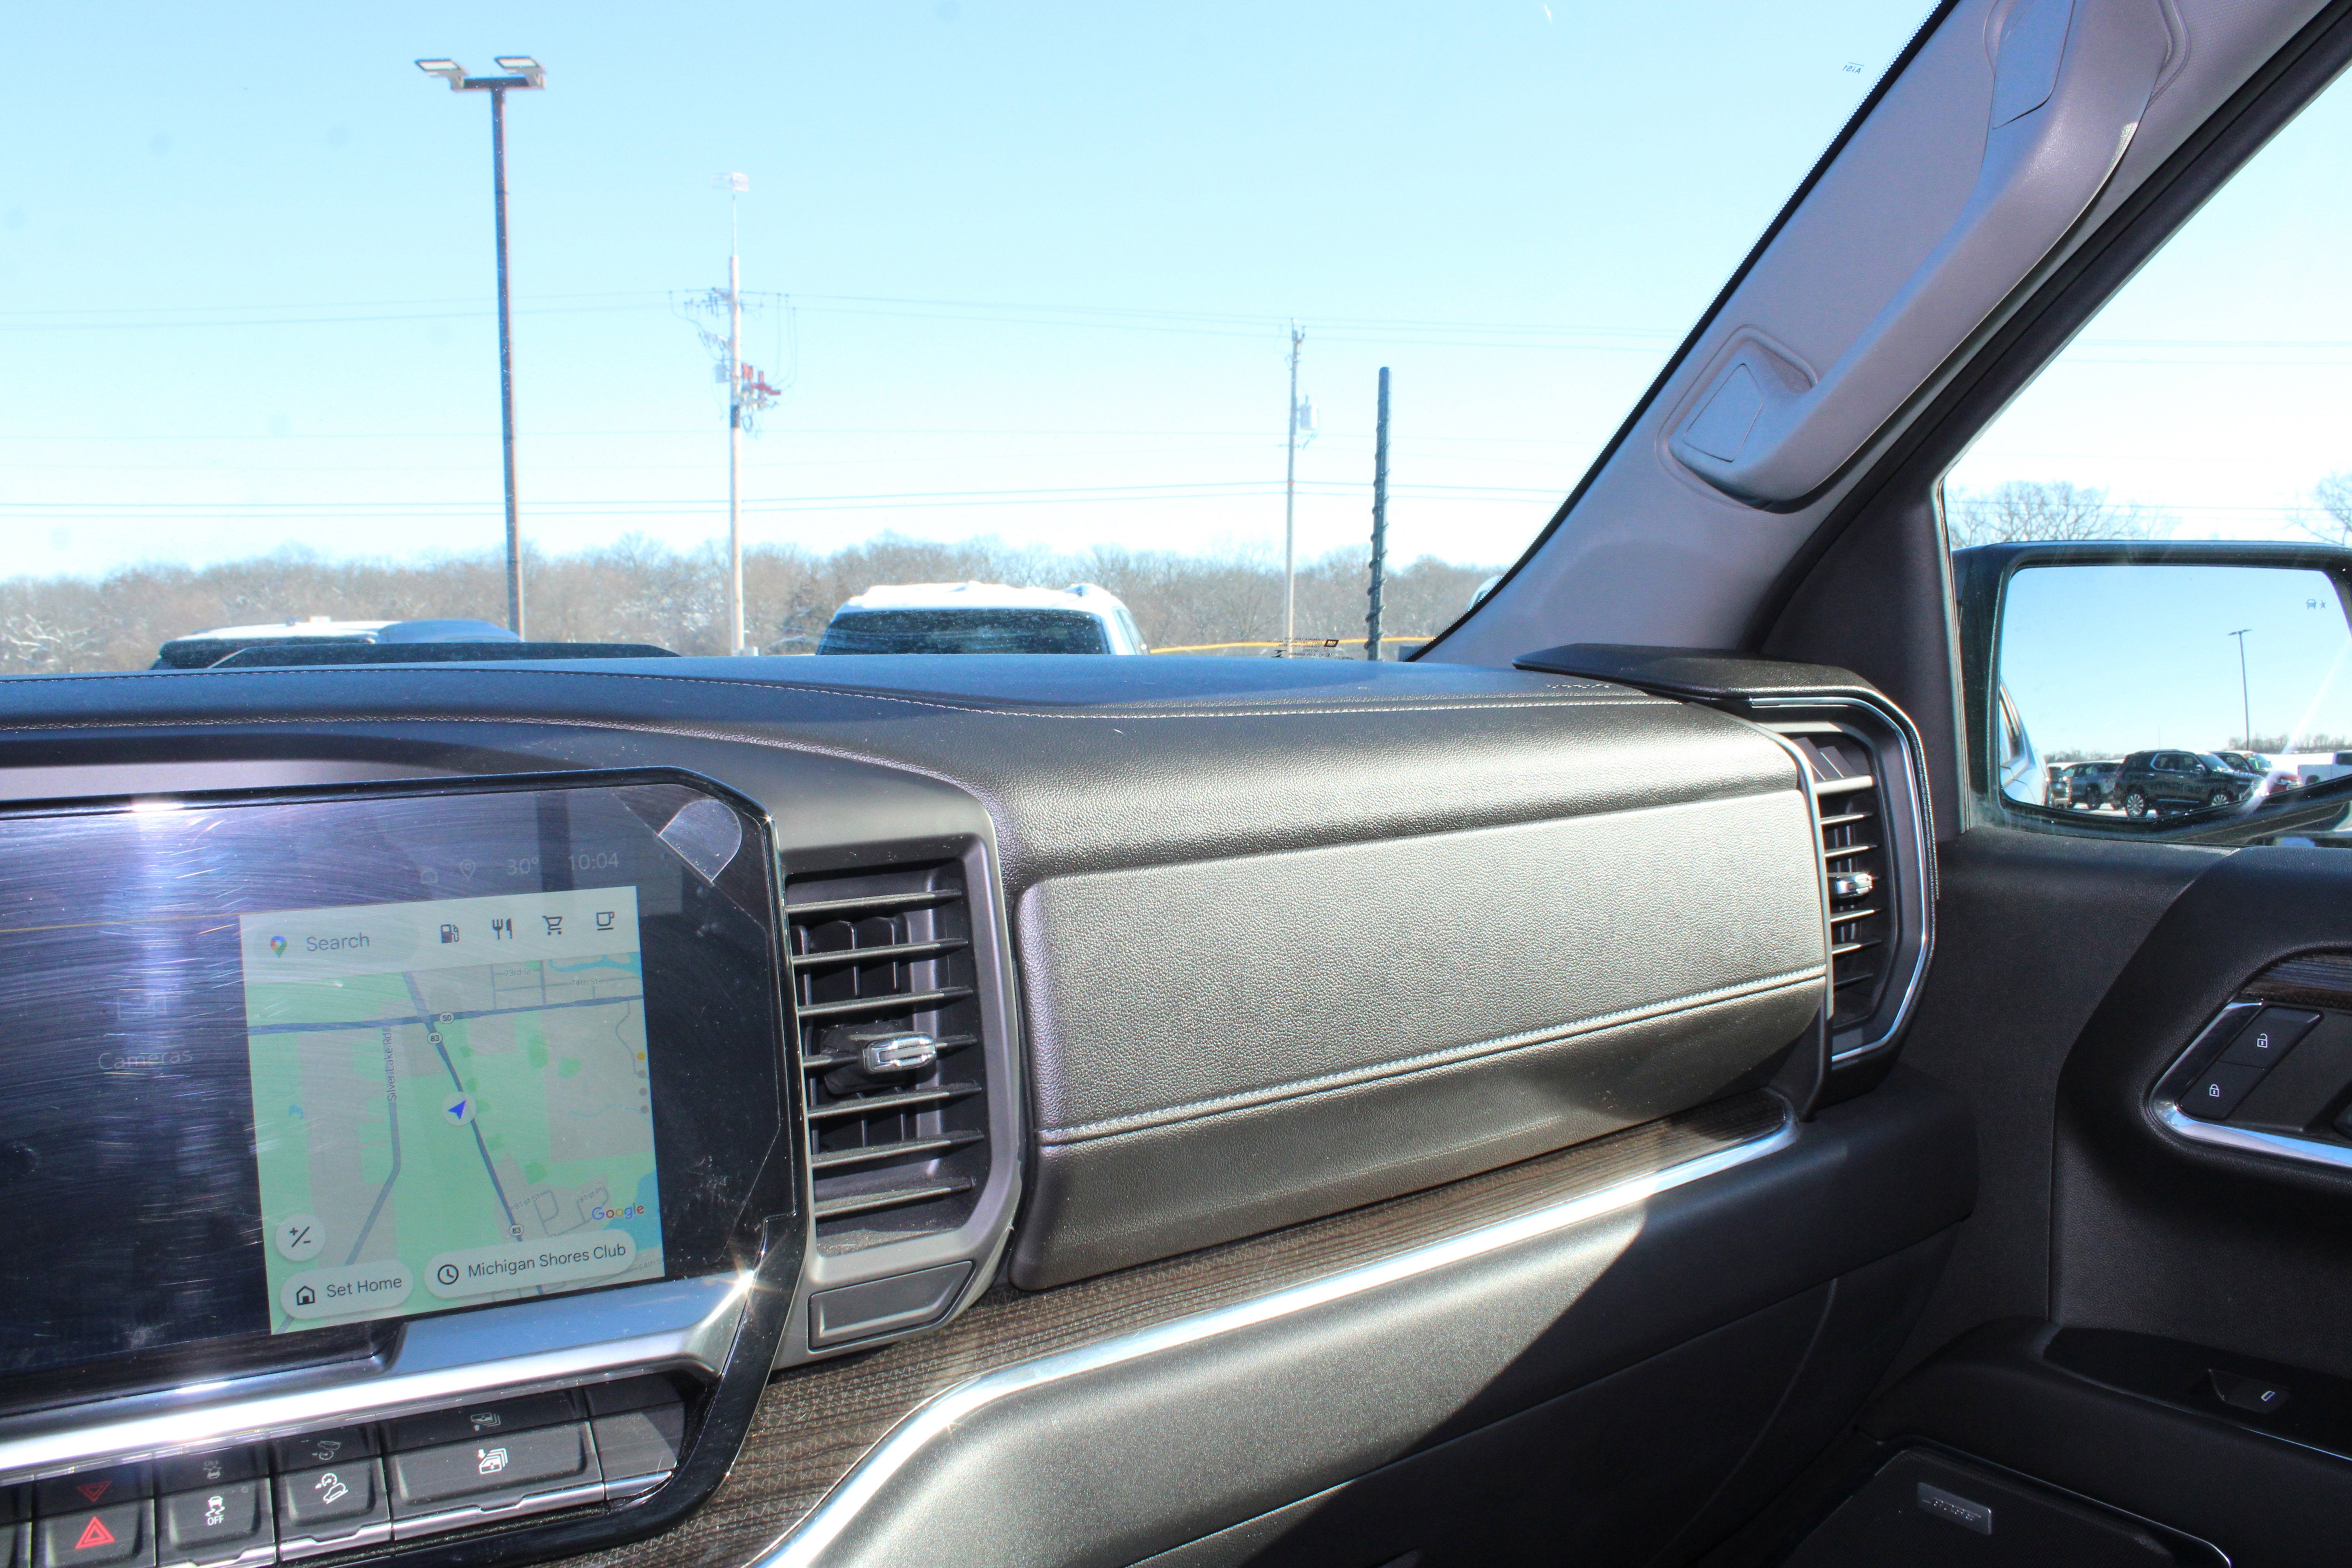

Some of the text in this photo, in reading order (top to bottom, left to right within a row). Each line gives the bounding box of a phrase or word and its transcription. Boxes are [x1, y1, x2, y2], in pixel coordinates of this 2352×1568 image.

[568, 852, 619, 870] 10:04
[306, 931, 370, 952] Search
[98, 1050, 193, 1070] Cameras
[382, 1032, 397, 1101] Silver Lake Rd
[592, 1203, 644, 1220] Google
[468, 1243, 626, 1277] Michigan Shores Club
[327, 1278, 402, 1297] Set Home
[207, 1514, 224, 1526] OFF
